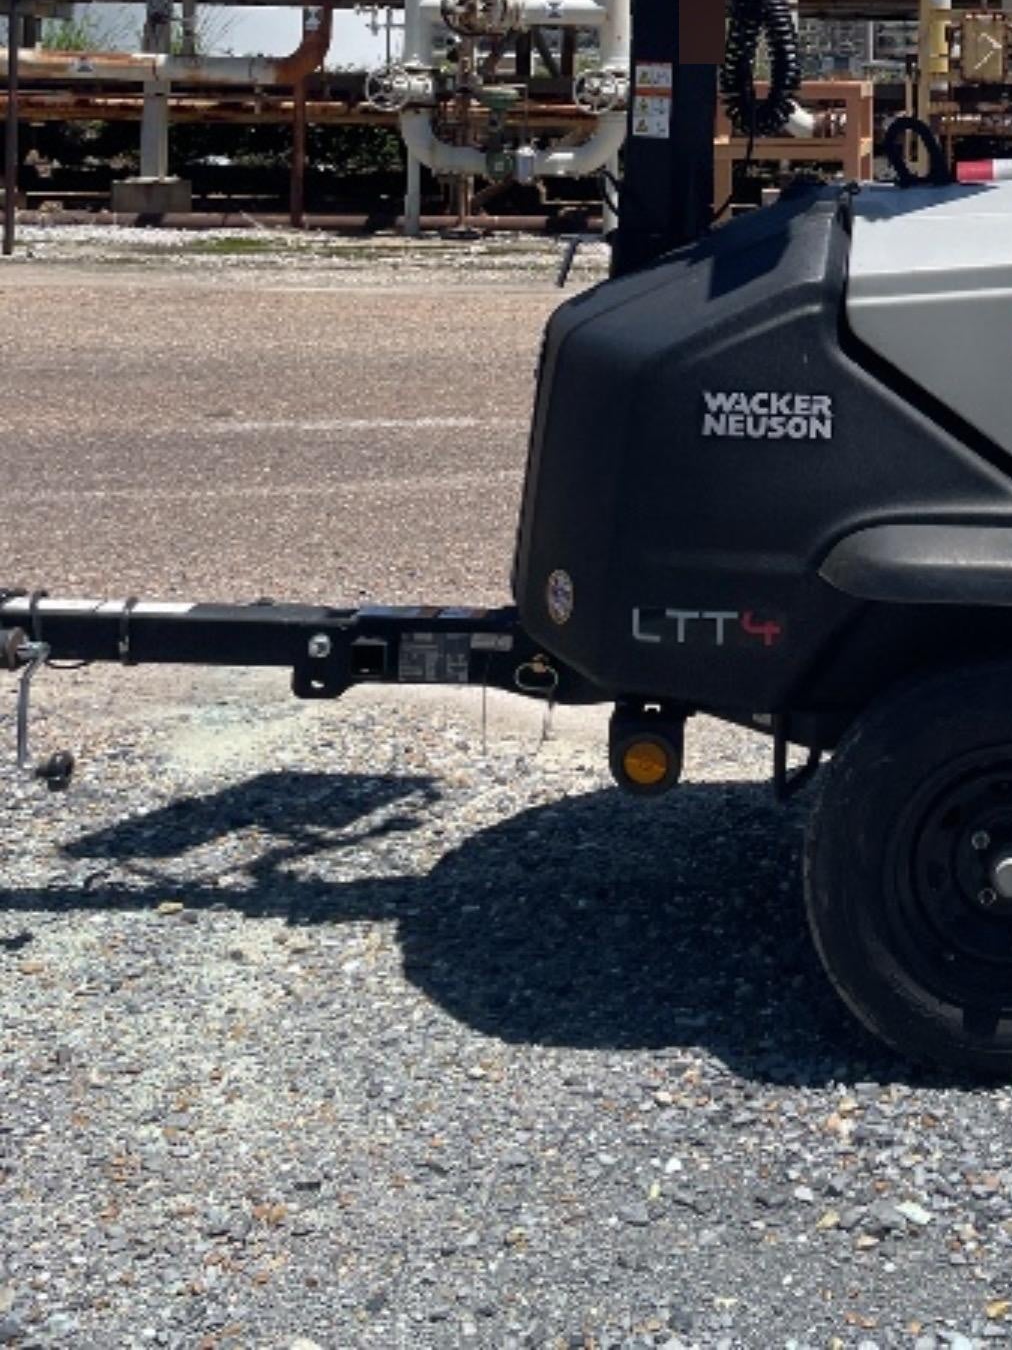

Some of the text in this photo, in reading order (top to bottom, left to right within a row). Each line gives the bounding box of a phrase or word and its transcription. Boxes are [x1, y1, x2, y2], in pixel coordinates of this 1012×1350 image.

[701, 392, 833, 417] WACKER
[701, 414, 832, 440] NEUSON
[632, 606, 781, 646] LTT4
